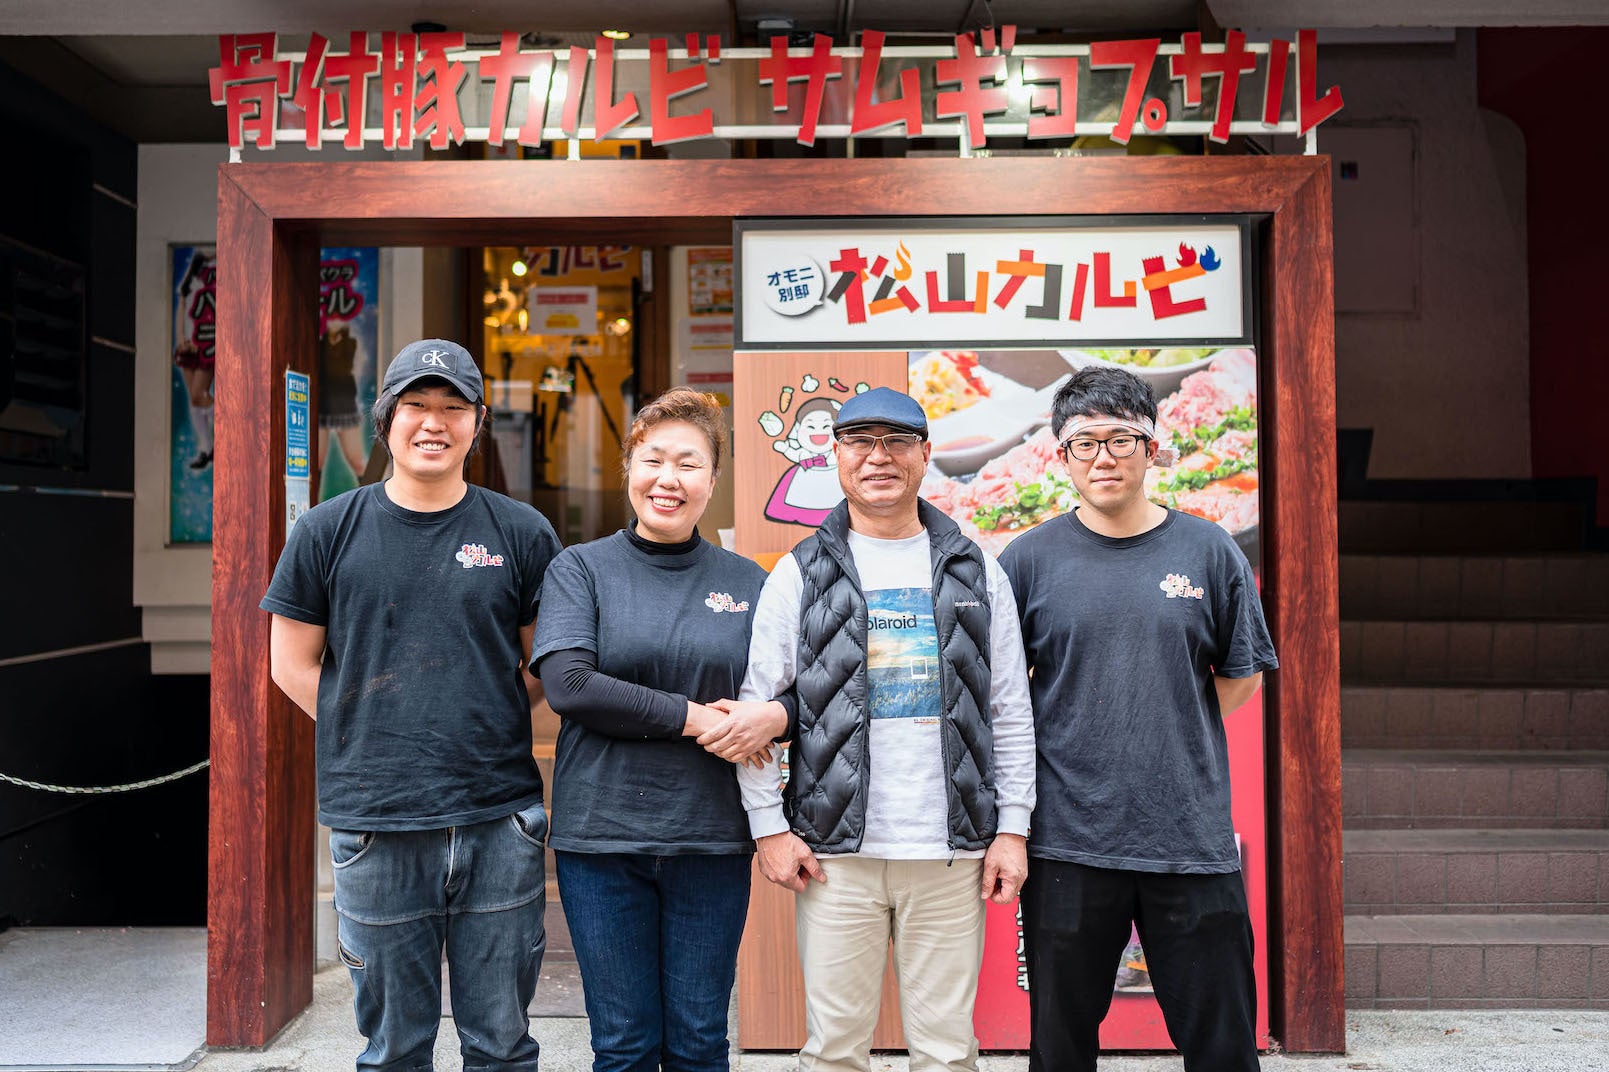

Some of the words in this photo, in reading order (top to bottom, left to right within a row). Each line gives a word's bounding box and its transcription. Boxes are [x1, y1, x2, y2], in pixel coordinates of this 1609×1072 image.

[208, 30, 721, 151] 骨付豚カルビ
[759, 25, 1344, 148] サムギョプサル
[767, 265, 815, 287] オモニ
[827, 239, 1222, 325] 松山カルビ
[777, 283, 811, 303] 別邸
[867, 615, 917, 631] olaroid
